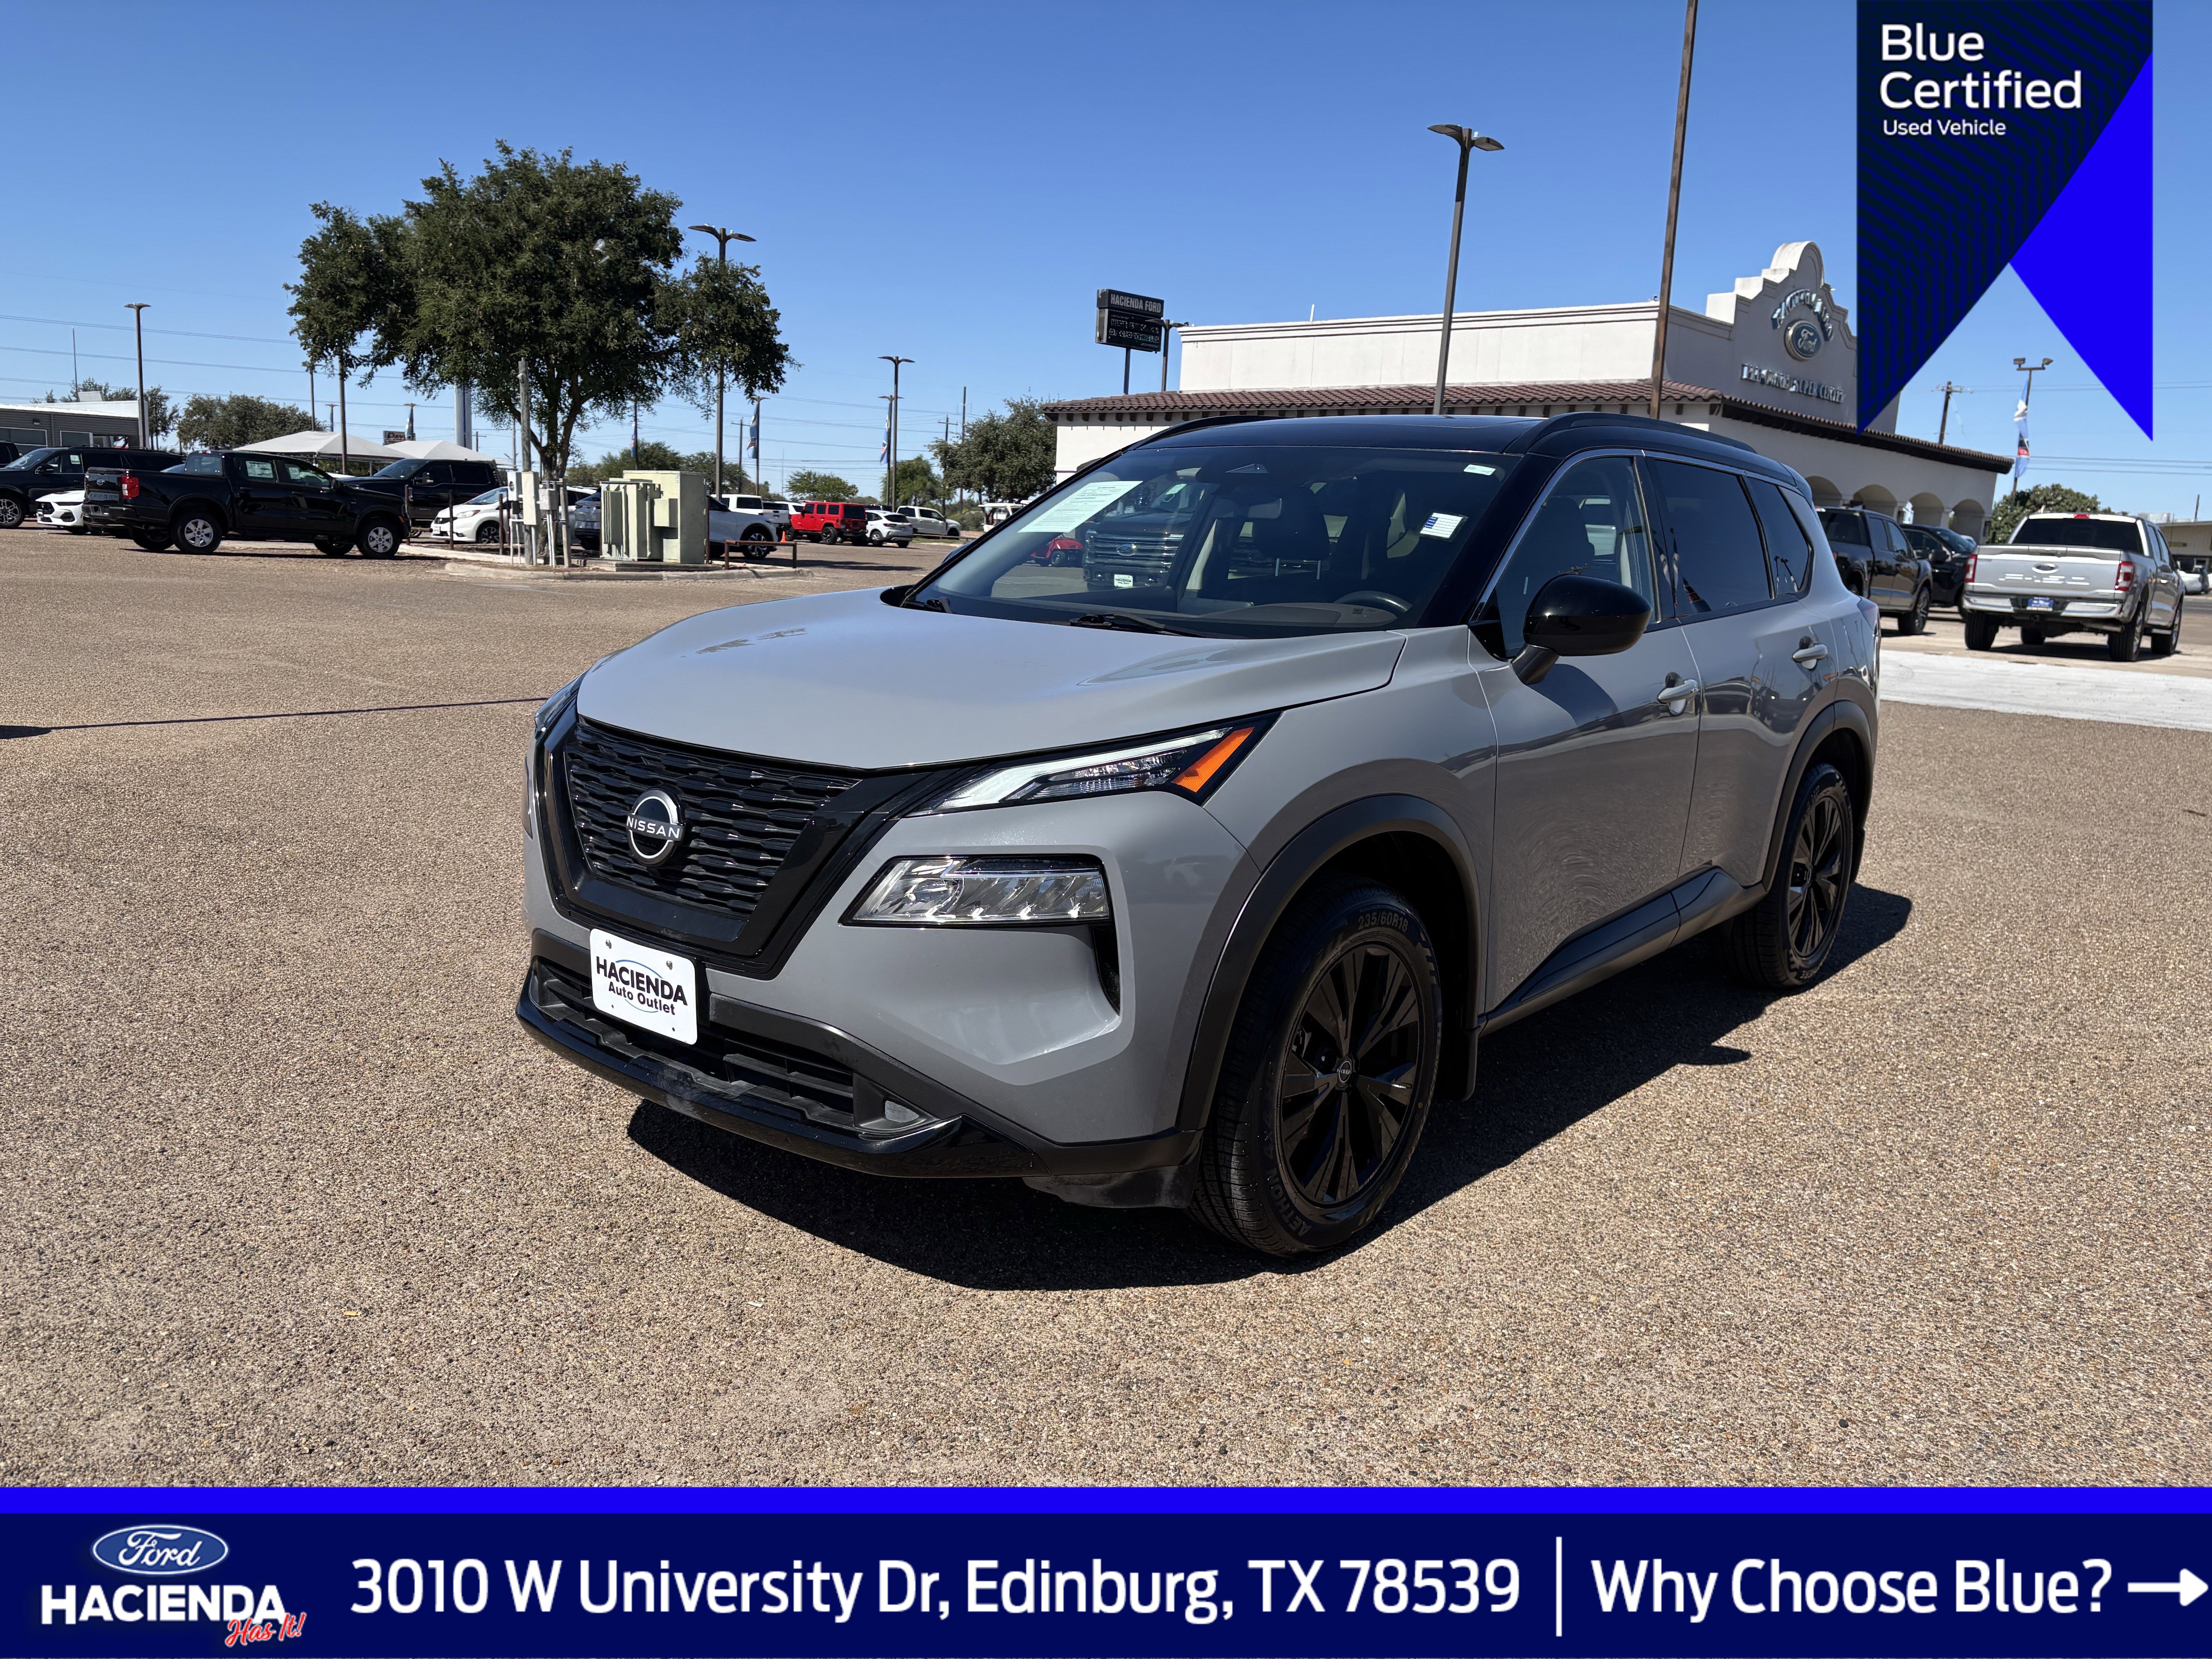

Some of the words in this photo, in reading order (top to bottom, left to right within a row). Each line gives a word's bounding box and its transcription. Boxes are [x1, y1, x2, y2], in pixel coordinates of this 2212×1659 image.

[1110, 293, 1143, 310] HACIENDA
[1145, 300, 1161, 313] FORD
[626, 816, 680, 839] NISSAN
[1358, 911, 1409, 933] 235/60R18
[596, 956, 688, 1006] HACIENDA
[608, 981, 634, 1001] Auto
[637, 992, 676, 1015] Outlet
